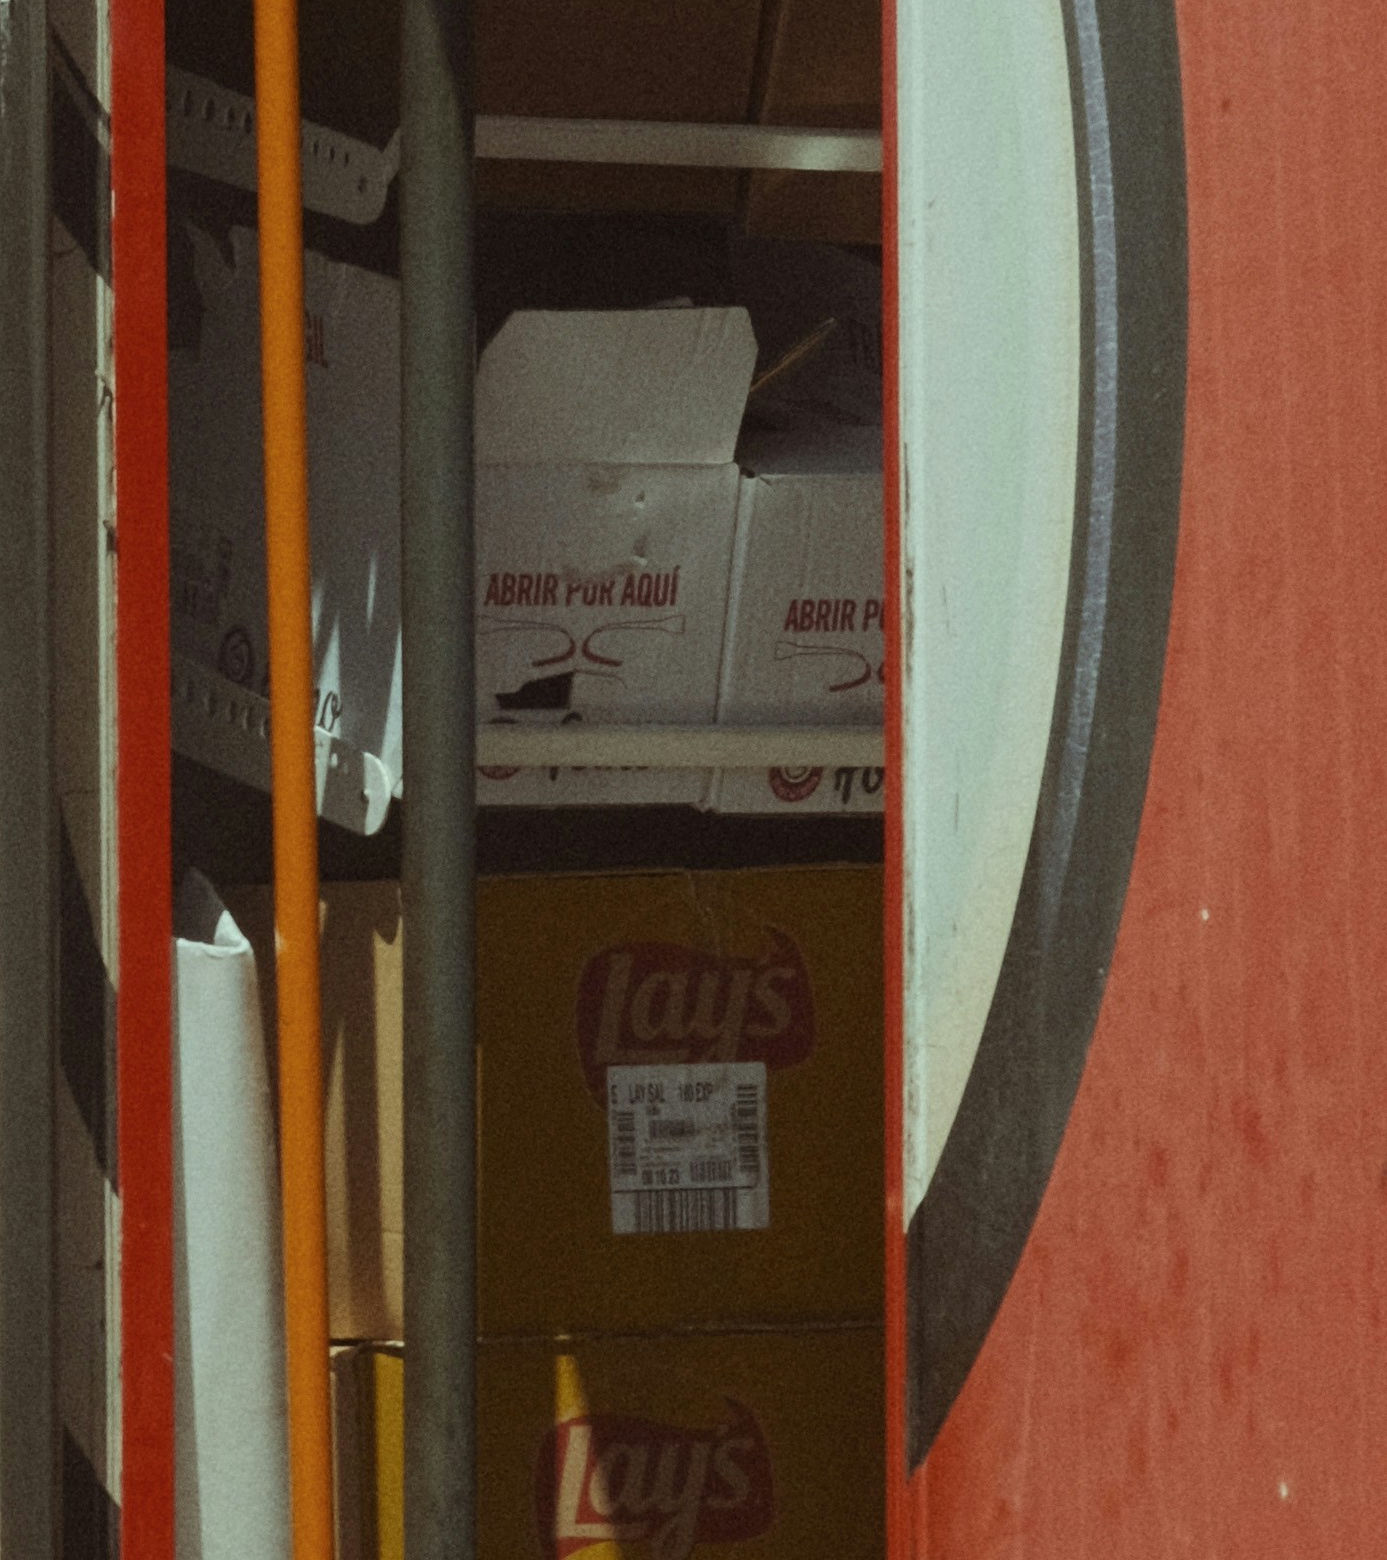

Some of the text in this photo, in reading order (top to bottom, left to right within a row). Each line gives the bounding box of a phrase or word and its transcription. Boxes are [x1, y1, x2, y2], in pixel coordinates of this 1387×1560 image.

[483, 572, 559, 606] ABRIR
[621, 565, 680, 607] AQUÍ
[783, 599, 856, 632] ABRIR
